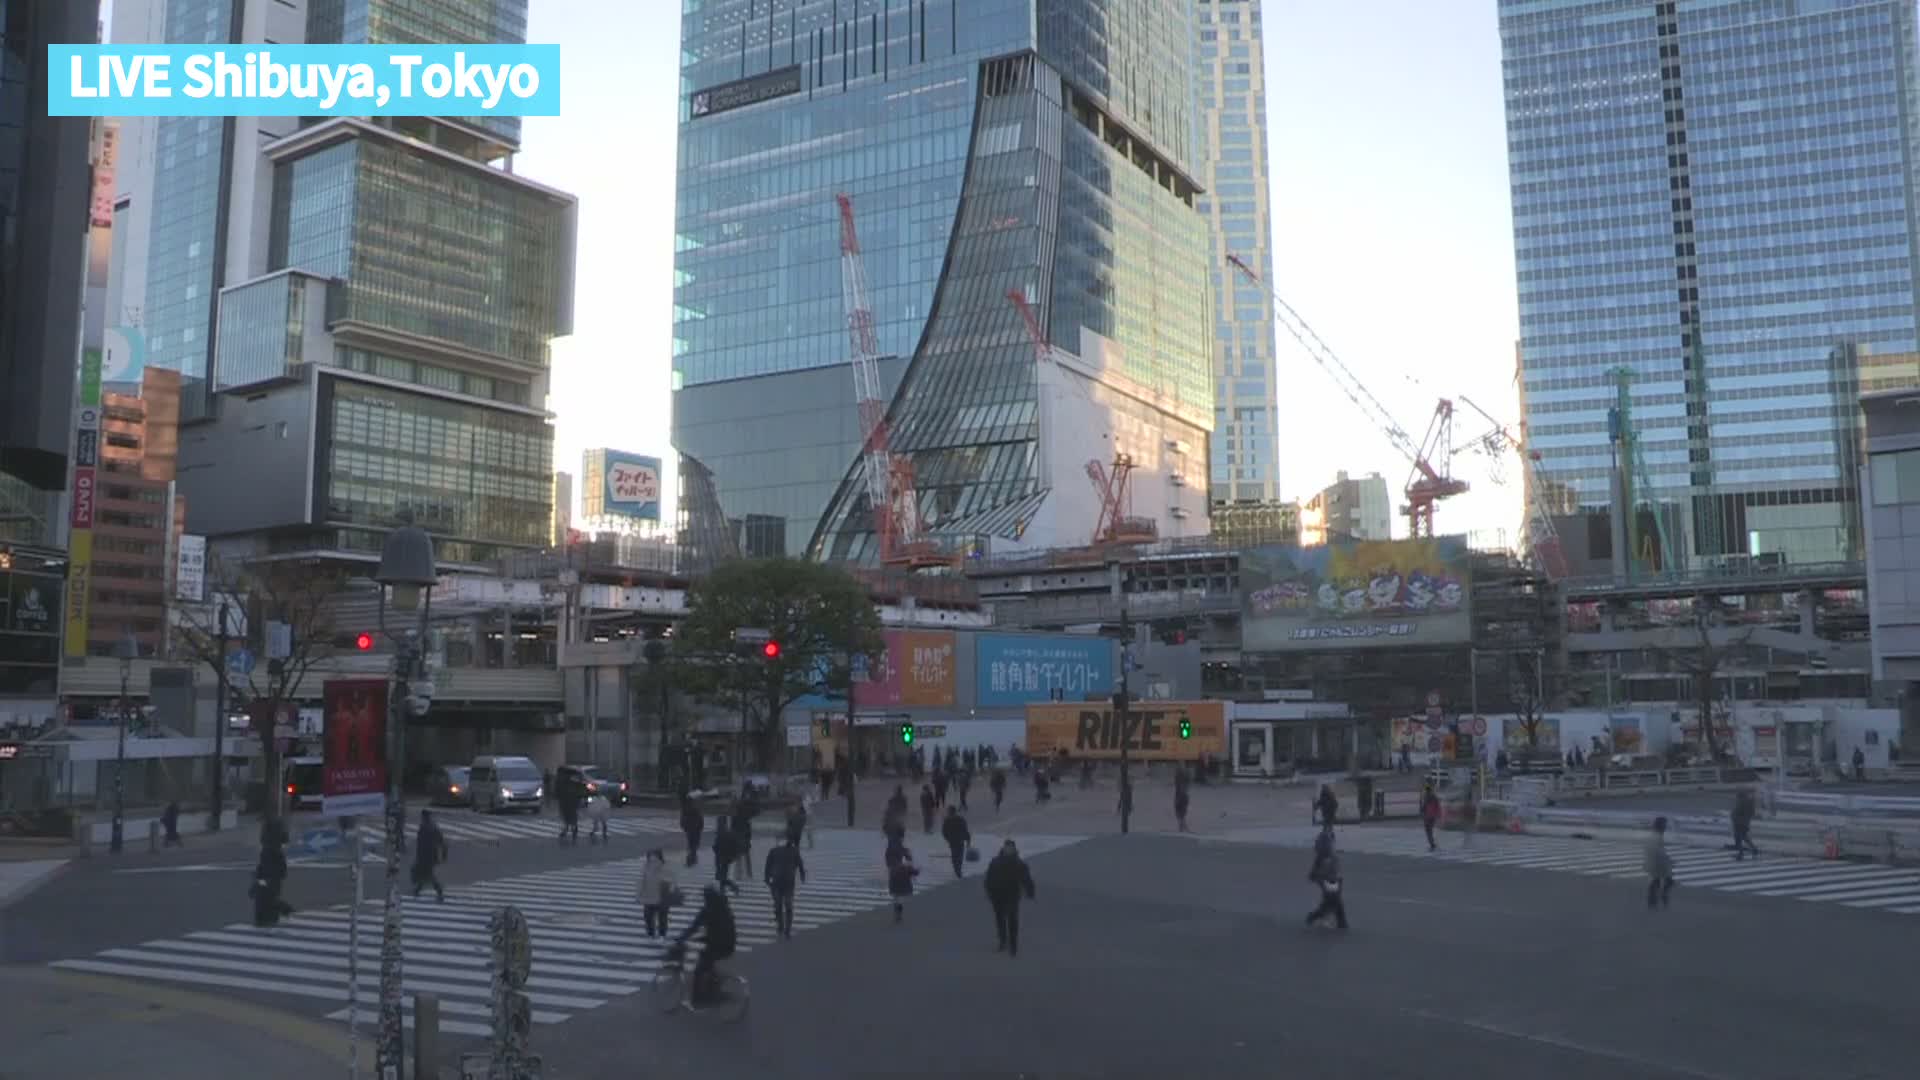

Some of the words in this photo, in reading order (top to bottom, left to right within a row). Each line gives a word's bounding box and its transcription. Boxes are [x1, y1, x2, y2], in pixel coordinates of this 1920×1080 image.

[614, 469, 653, 484] ファイト
[991, 660, 1099, 692] 龍角散ダイレクト
